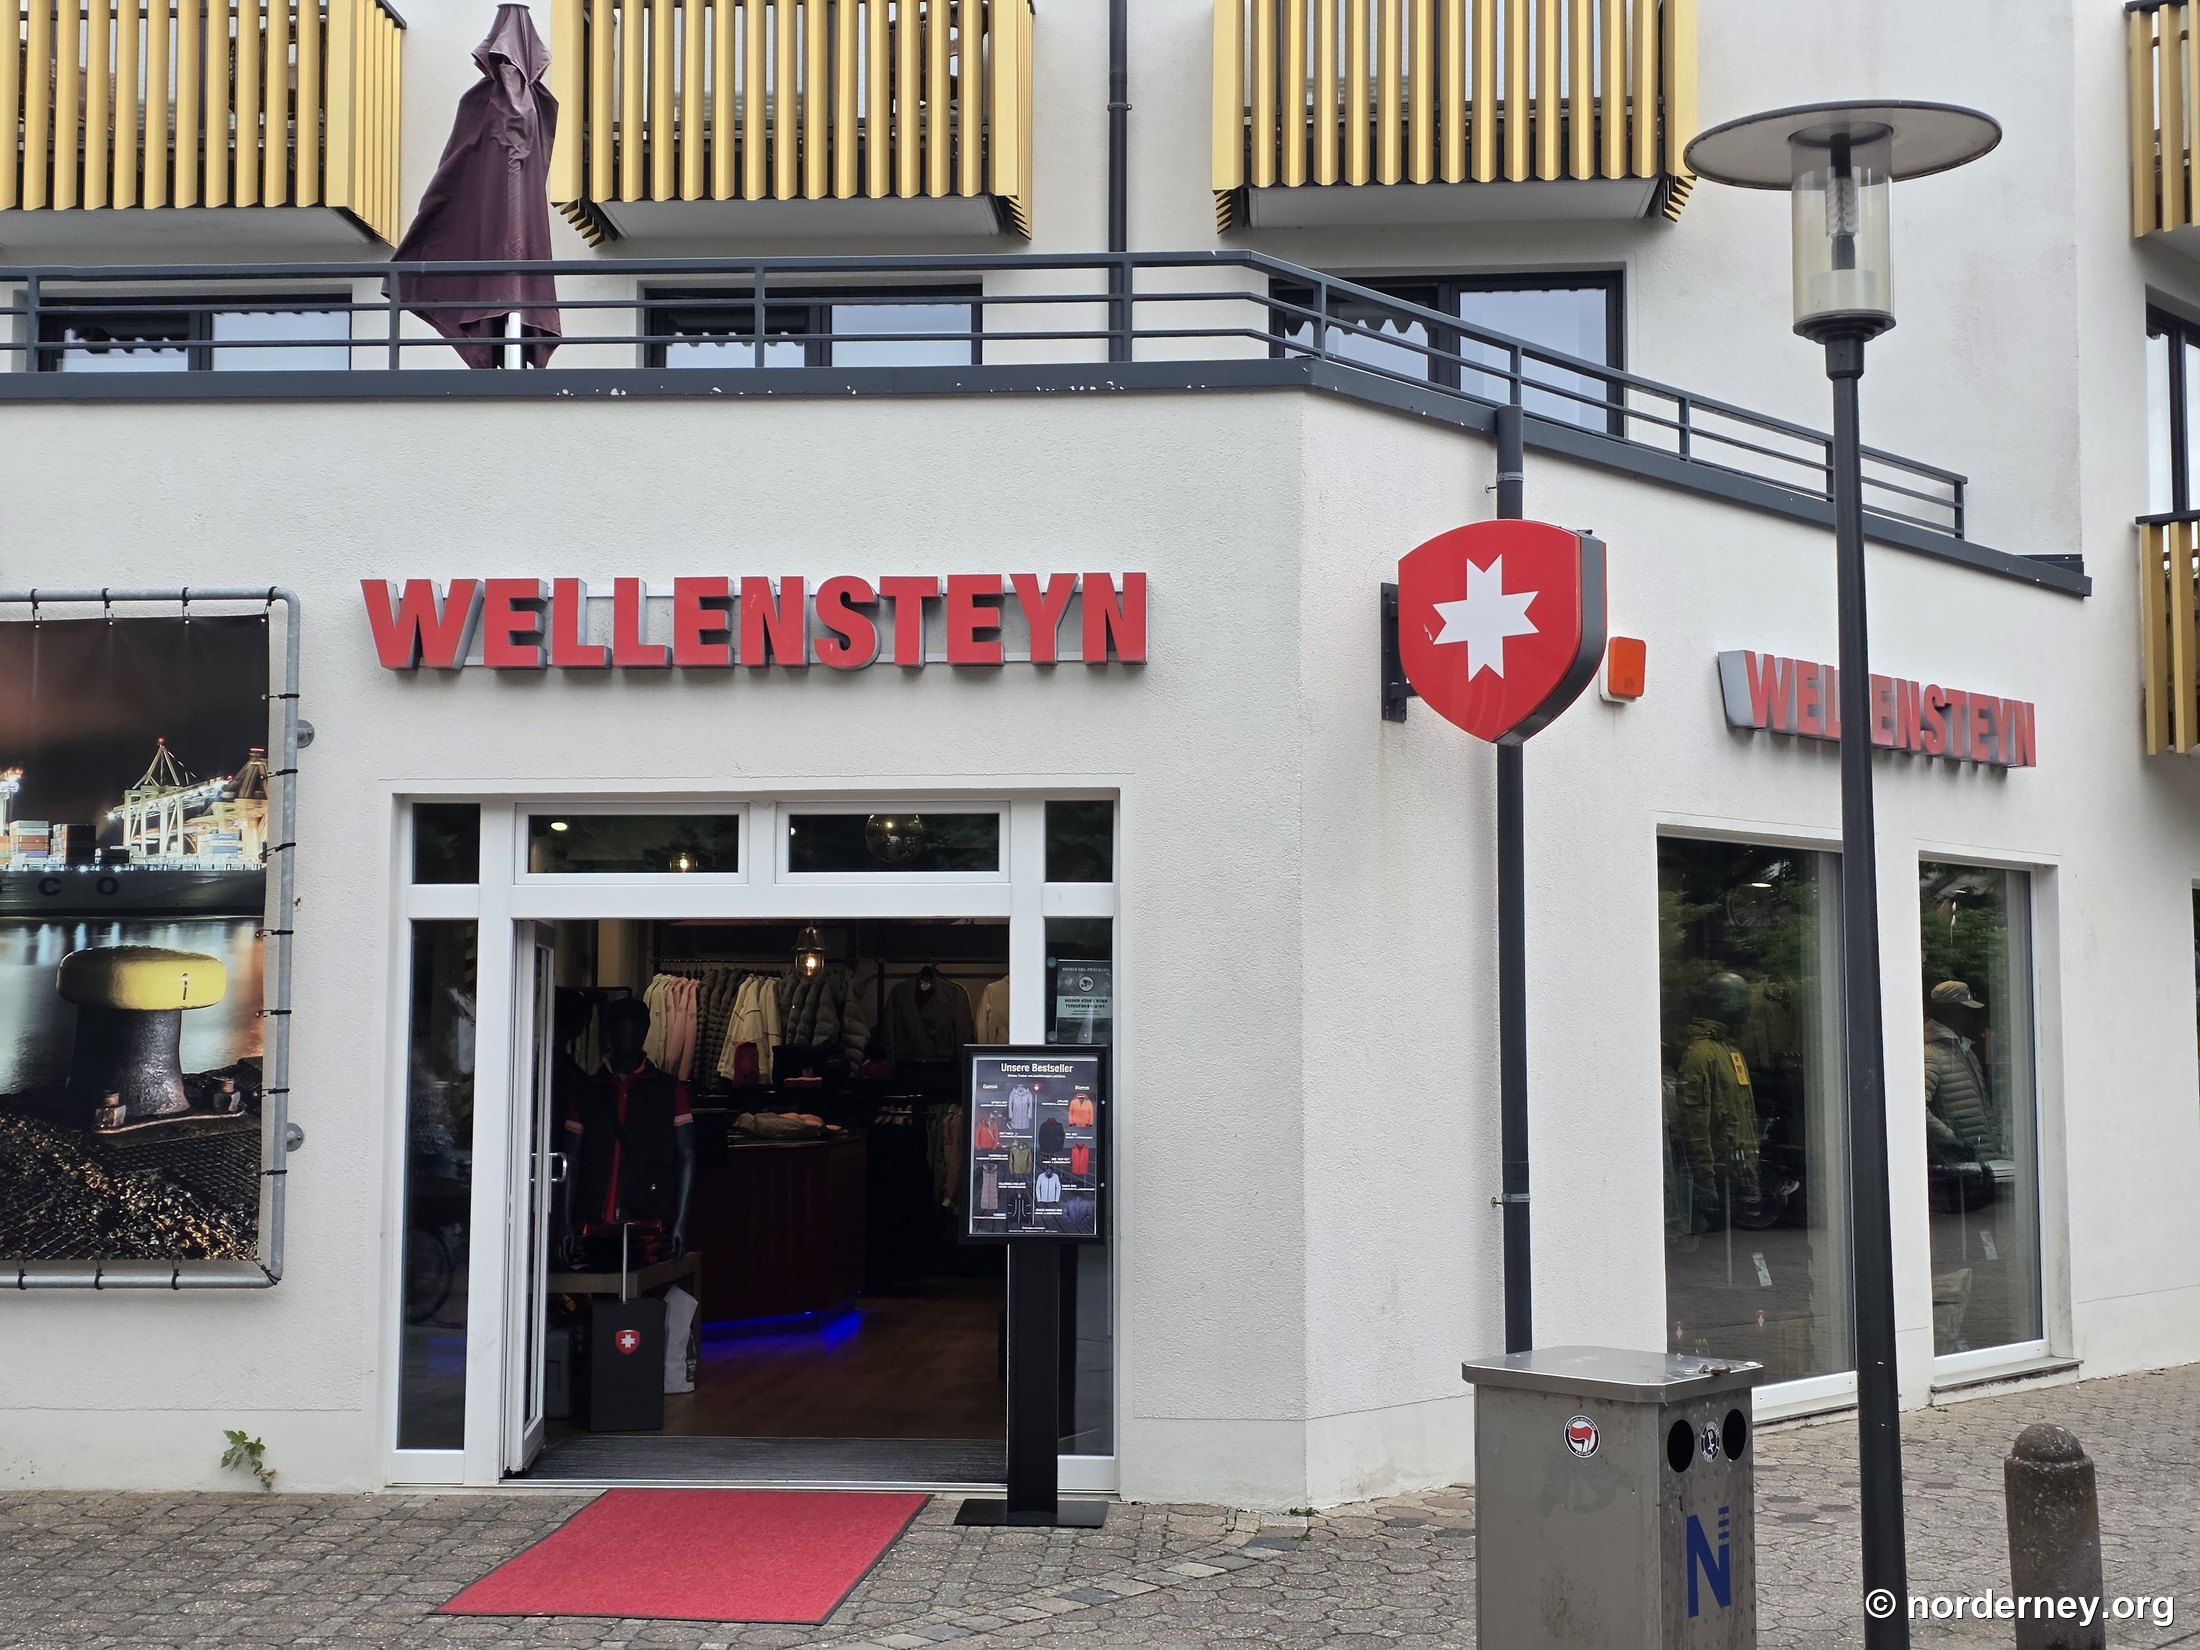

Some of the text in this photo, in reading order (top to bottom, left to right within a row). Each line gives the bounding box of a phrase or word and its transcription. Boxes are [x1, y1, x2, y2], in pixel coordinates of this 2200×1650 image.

[360, 571, 1147, 671] WELLENSTEYN
[1738, 650, 2036, 767] WELENSTEYN
[1001, 1062, 1074, 1073] Unsere Bestseller
